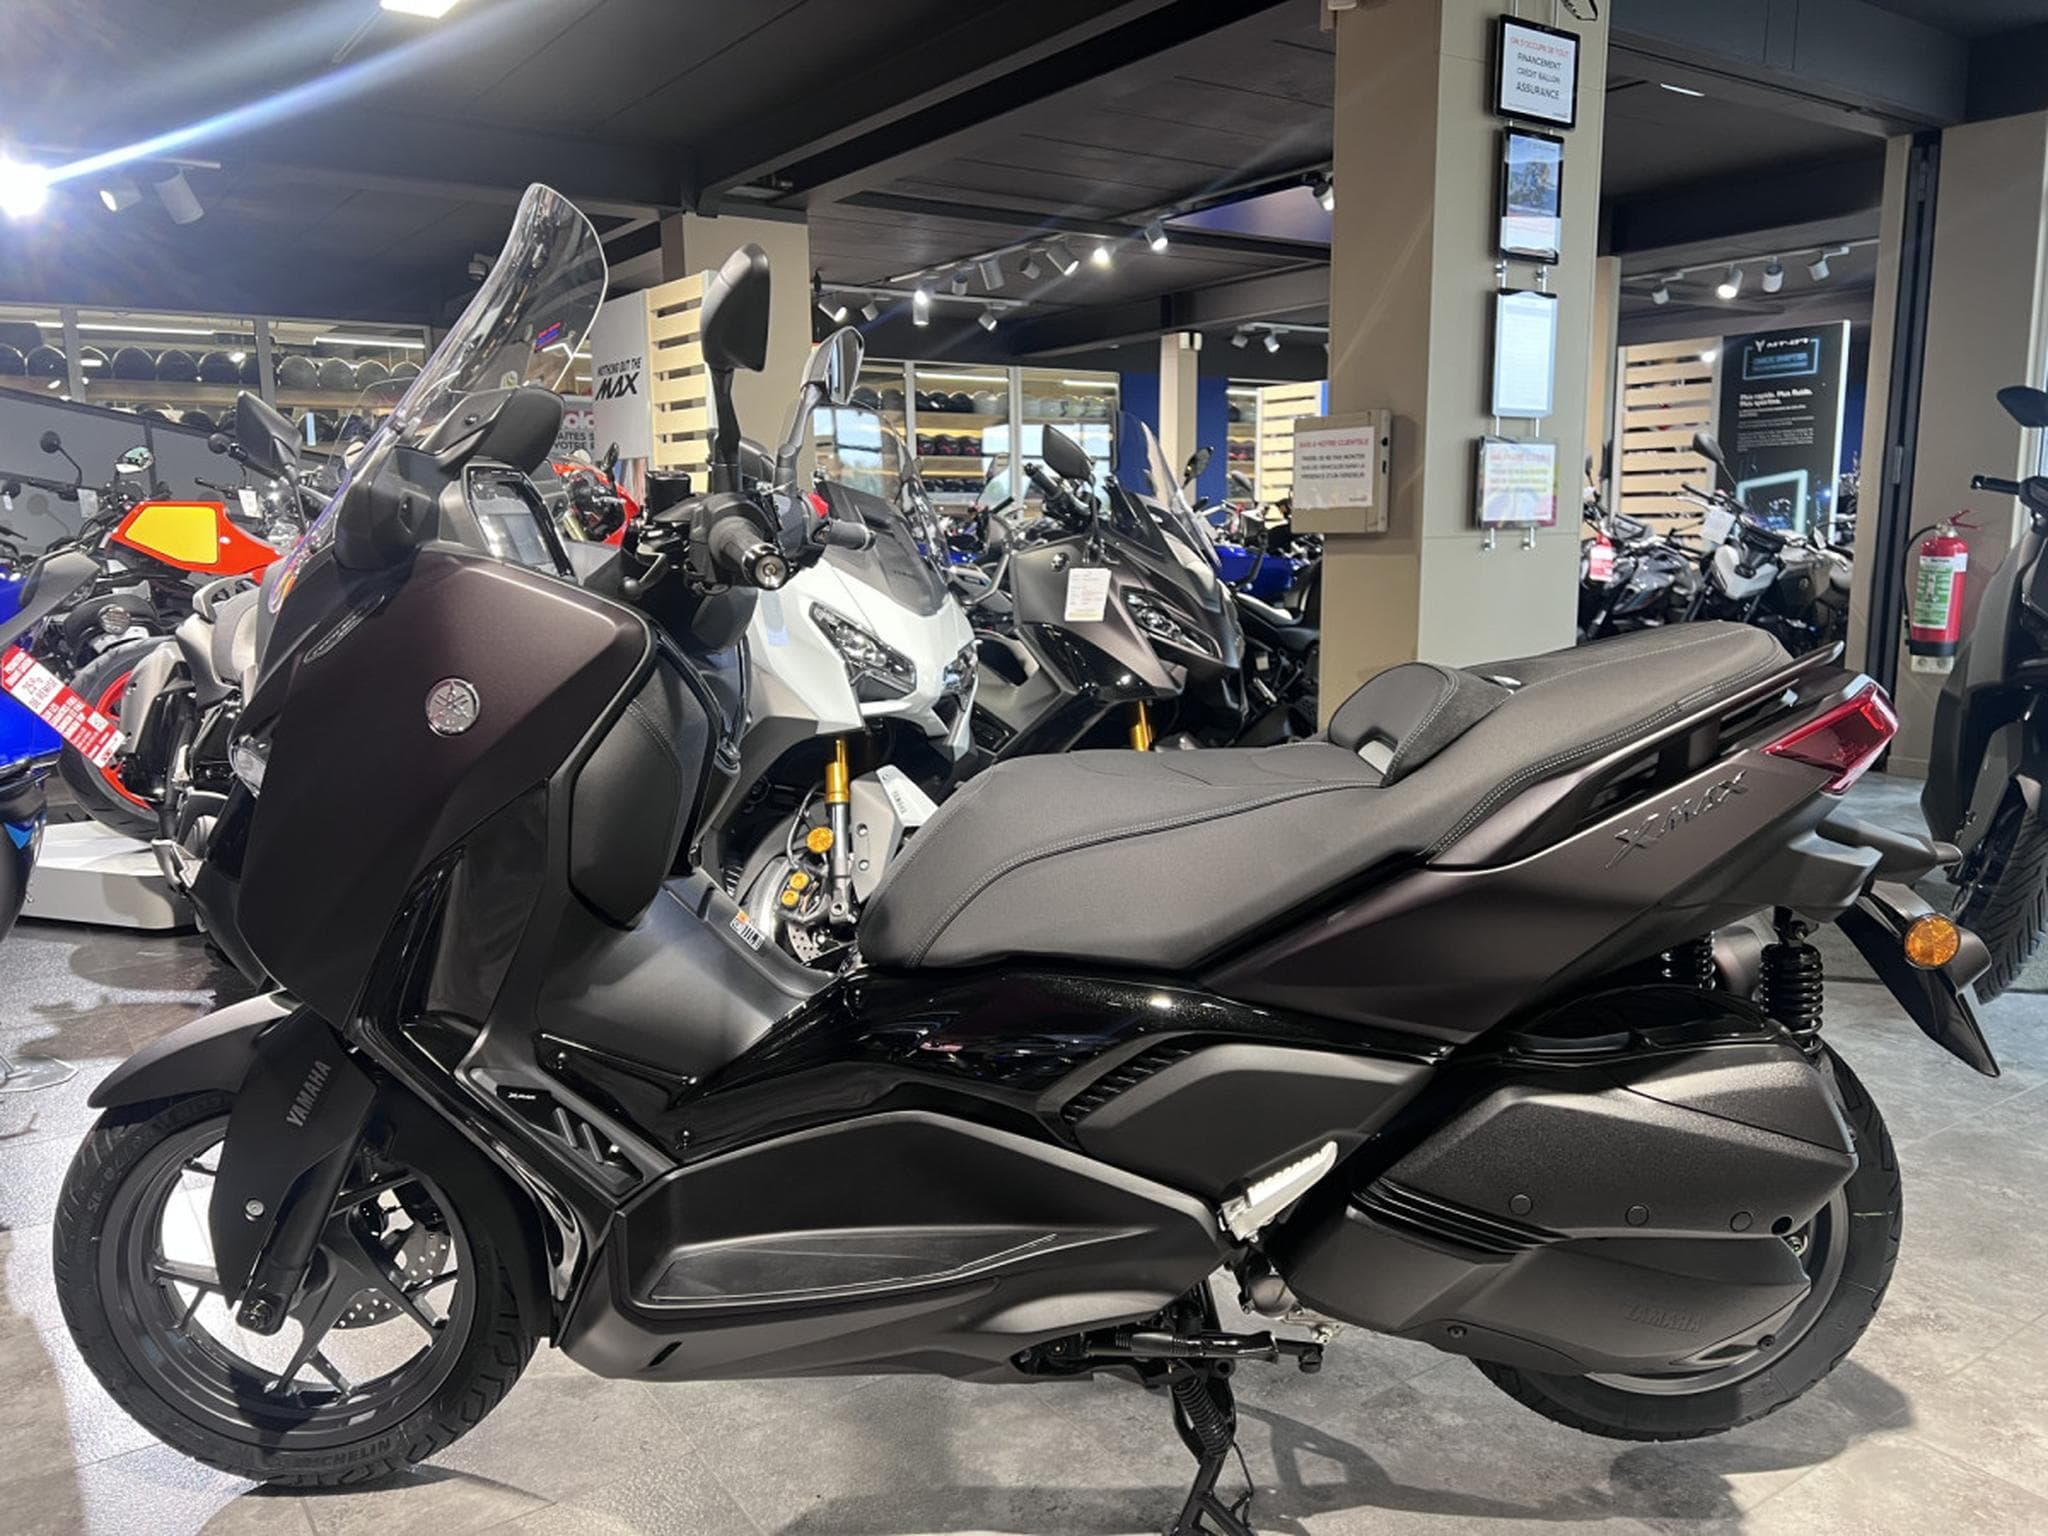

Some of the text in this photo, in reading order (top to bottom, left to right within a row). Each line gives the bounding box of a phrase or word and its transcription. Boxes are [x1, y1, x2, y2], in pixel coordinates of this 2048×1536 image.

[1517, 52, 1562, 69] FINANCEMENT
[1516, 81, 1560, 100] ASSURANCE
[595, 372, 640, 400] MAX
[286, 1060, 331, 1128] YAMAHA
